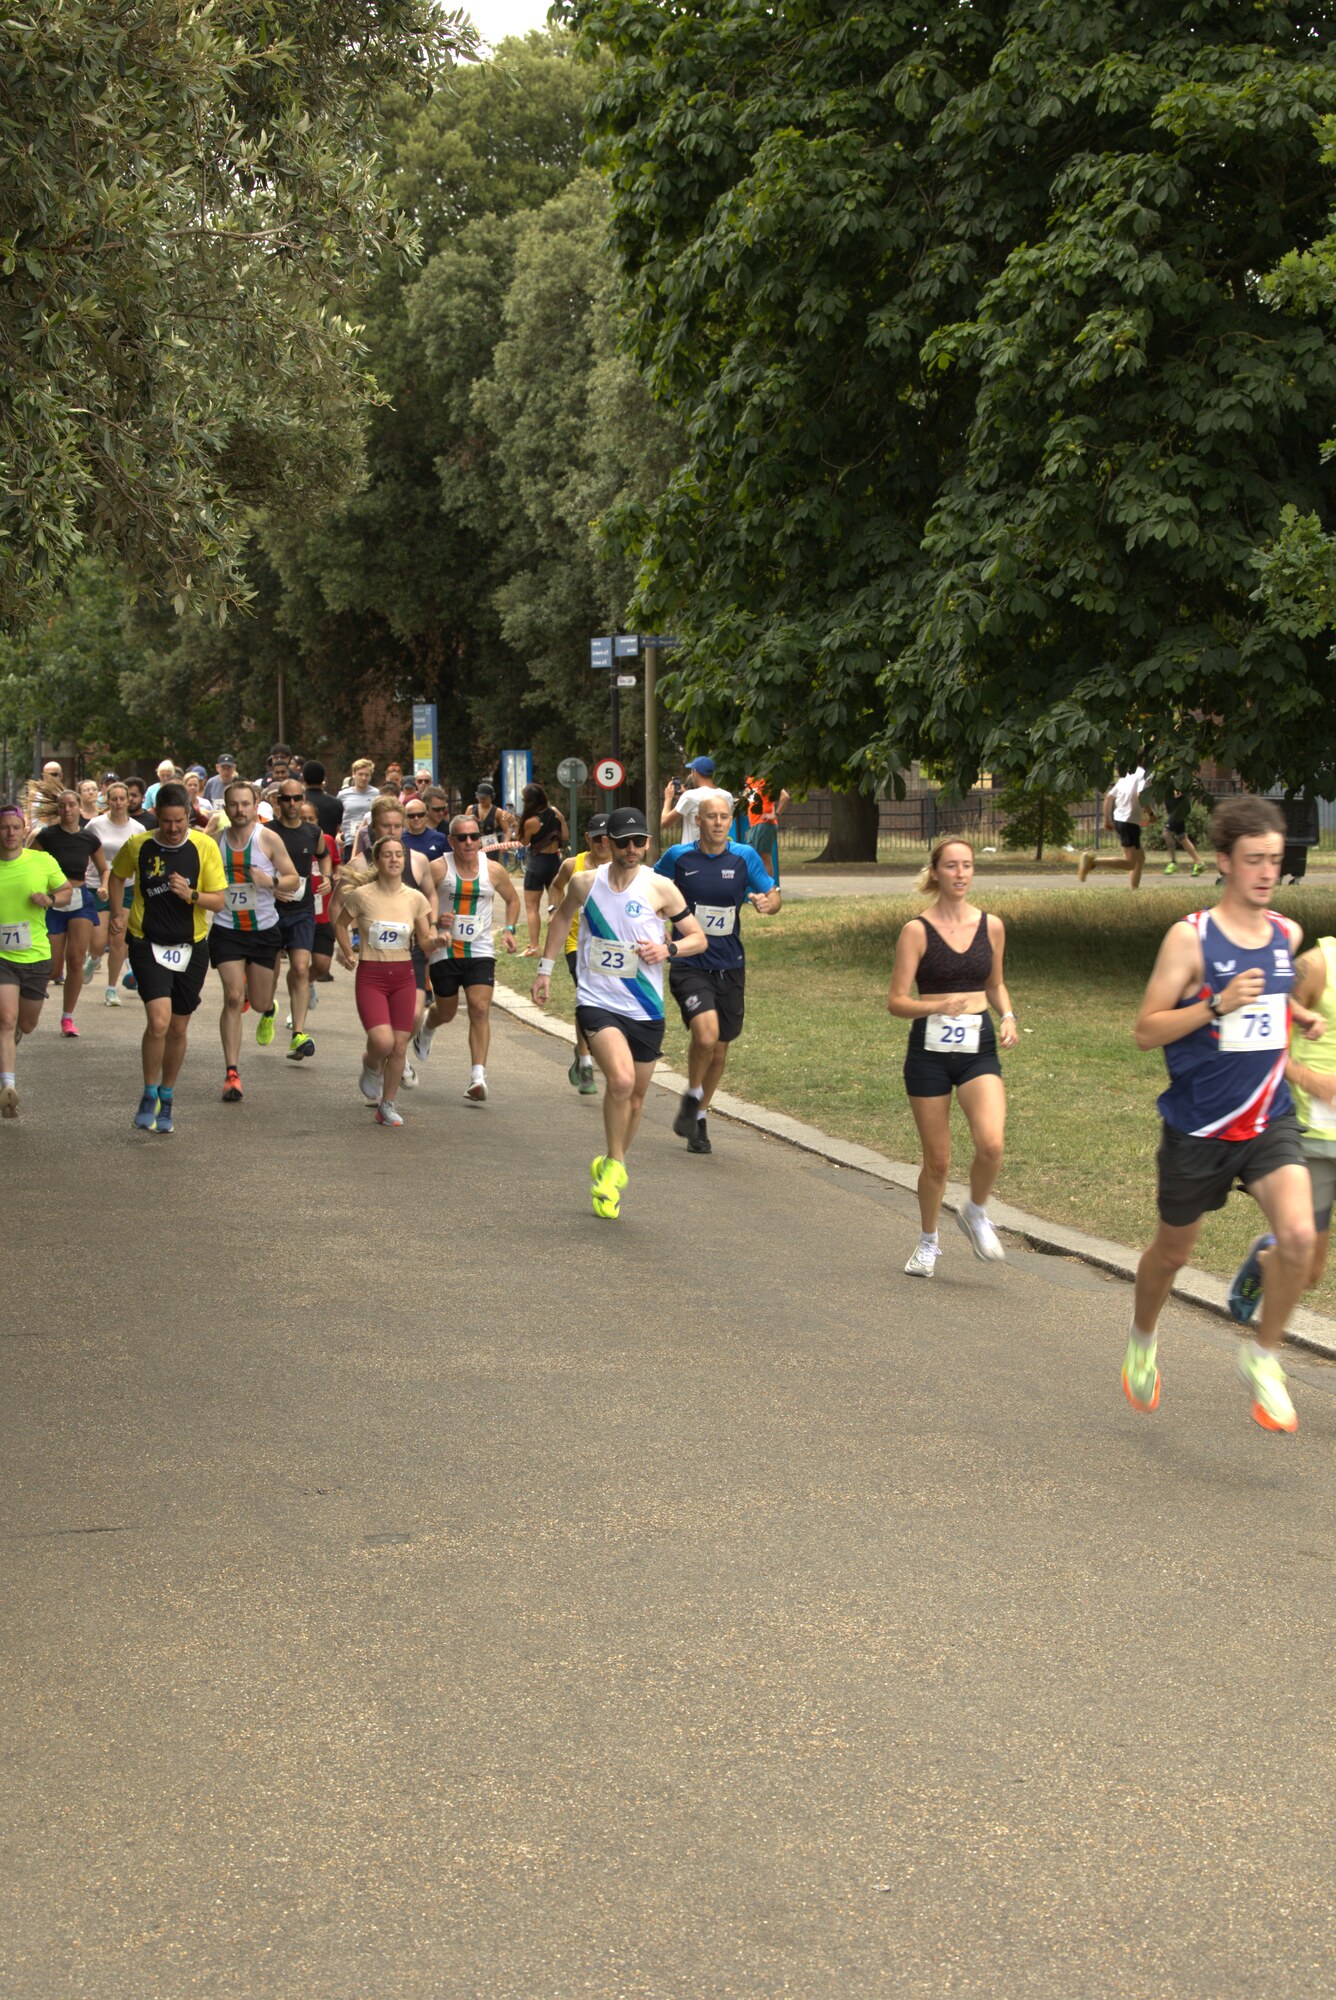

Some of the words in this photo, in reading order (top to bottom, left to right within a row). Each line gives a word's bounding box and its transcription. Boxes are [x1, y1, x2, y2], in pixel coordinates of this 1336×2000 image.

[605, 767, 614, 780] 5
[230, 892, 247, 904] 75
[458, 922, 474, 935] 16
[705, 915, 725, 929] 74
[2, 931, 20, 945] 71
[378, 930, 398, 943] 49
[162, 949, 181, 964] 40
[601, 950, 624, 969] 23
[1241, 1013, 1272, 1038] 78
[940, 1025, 966, 1043] 29
